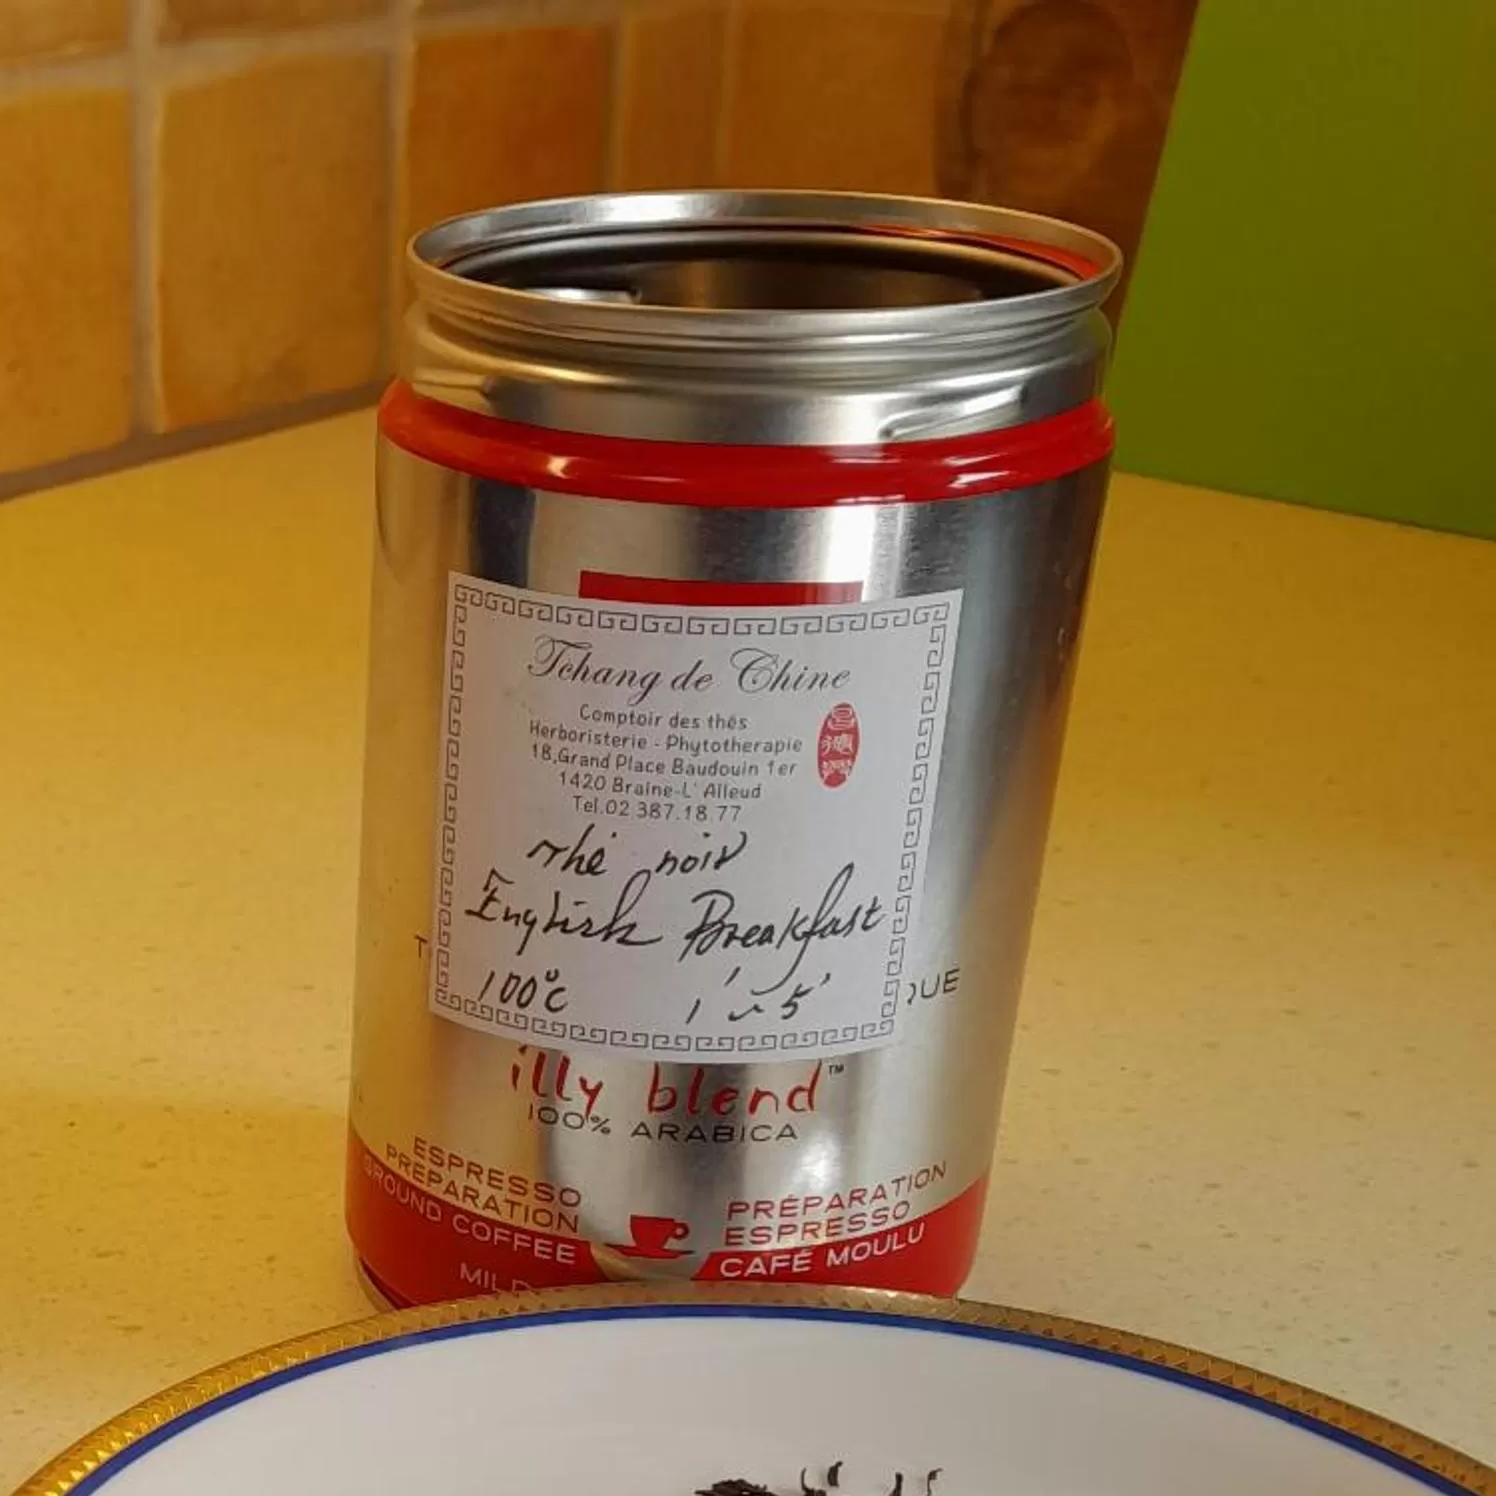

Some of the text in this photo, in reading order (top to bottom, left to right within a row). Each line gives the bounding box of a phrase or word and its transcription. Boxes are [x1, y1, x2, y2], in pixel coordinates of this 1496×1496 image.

[527, 635, 852, 706] Tchang de Chine
[529, 721, 647, 750] Herboristerie
[666, 735, 803, 756] Phytotherapie
[579, 703, 748, 730] Comptoir des thés
[559, 772, 606, 791] 1420
[615, 753, 666, 776] Place
[672, 758, 758, 777] Baudouin
[767, 760, 797, 777] 1er
[655, 831, 748, 876] noir
[464, 862, 885, 996] English Breakfast
[511, 1044, 603, 1117] illy
[528, 1103, 798, 1143] 100% ARABICA
[386, 1143, 578, 1233] PREPARATION
[413, 1136, 581, 1208] ESPRESSO
[727, 1160, 947, 1221] PRÉPARATION
[364, 1154, 576, 1264] GROUND COFFEE
[724, 1200, 910, 1246] ESPRESSO
[827, 1222, 926, 1267] MOULU
